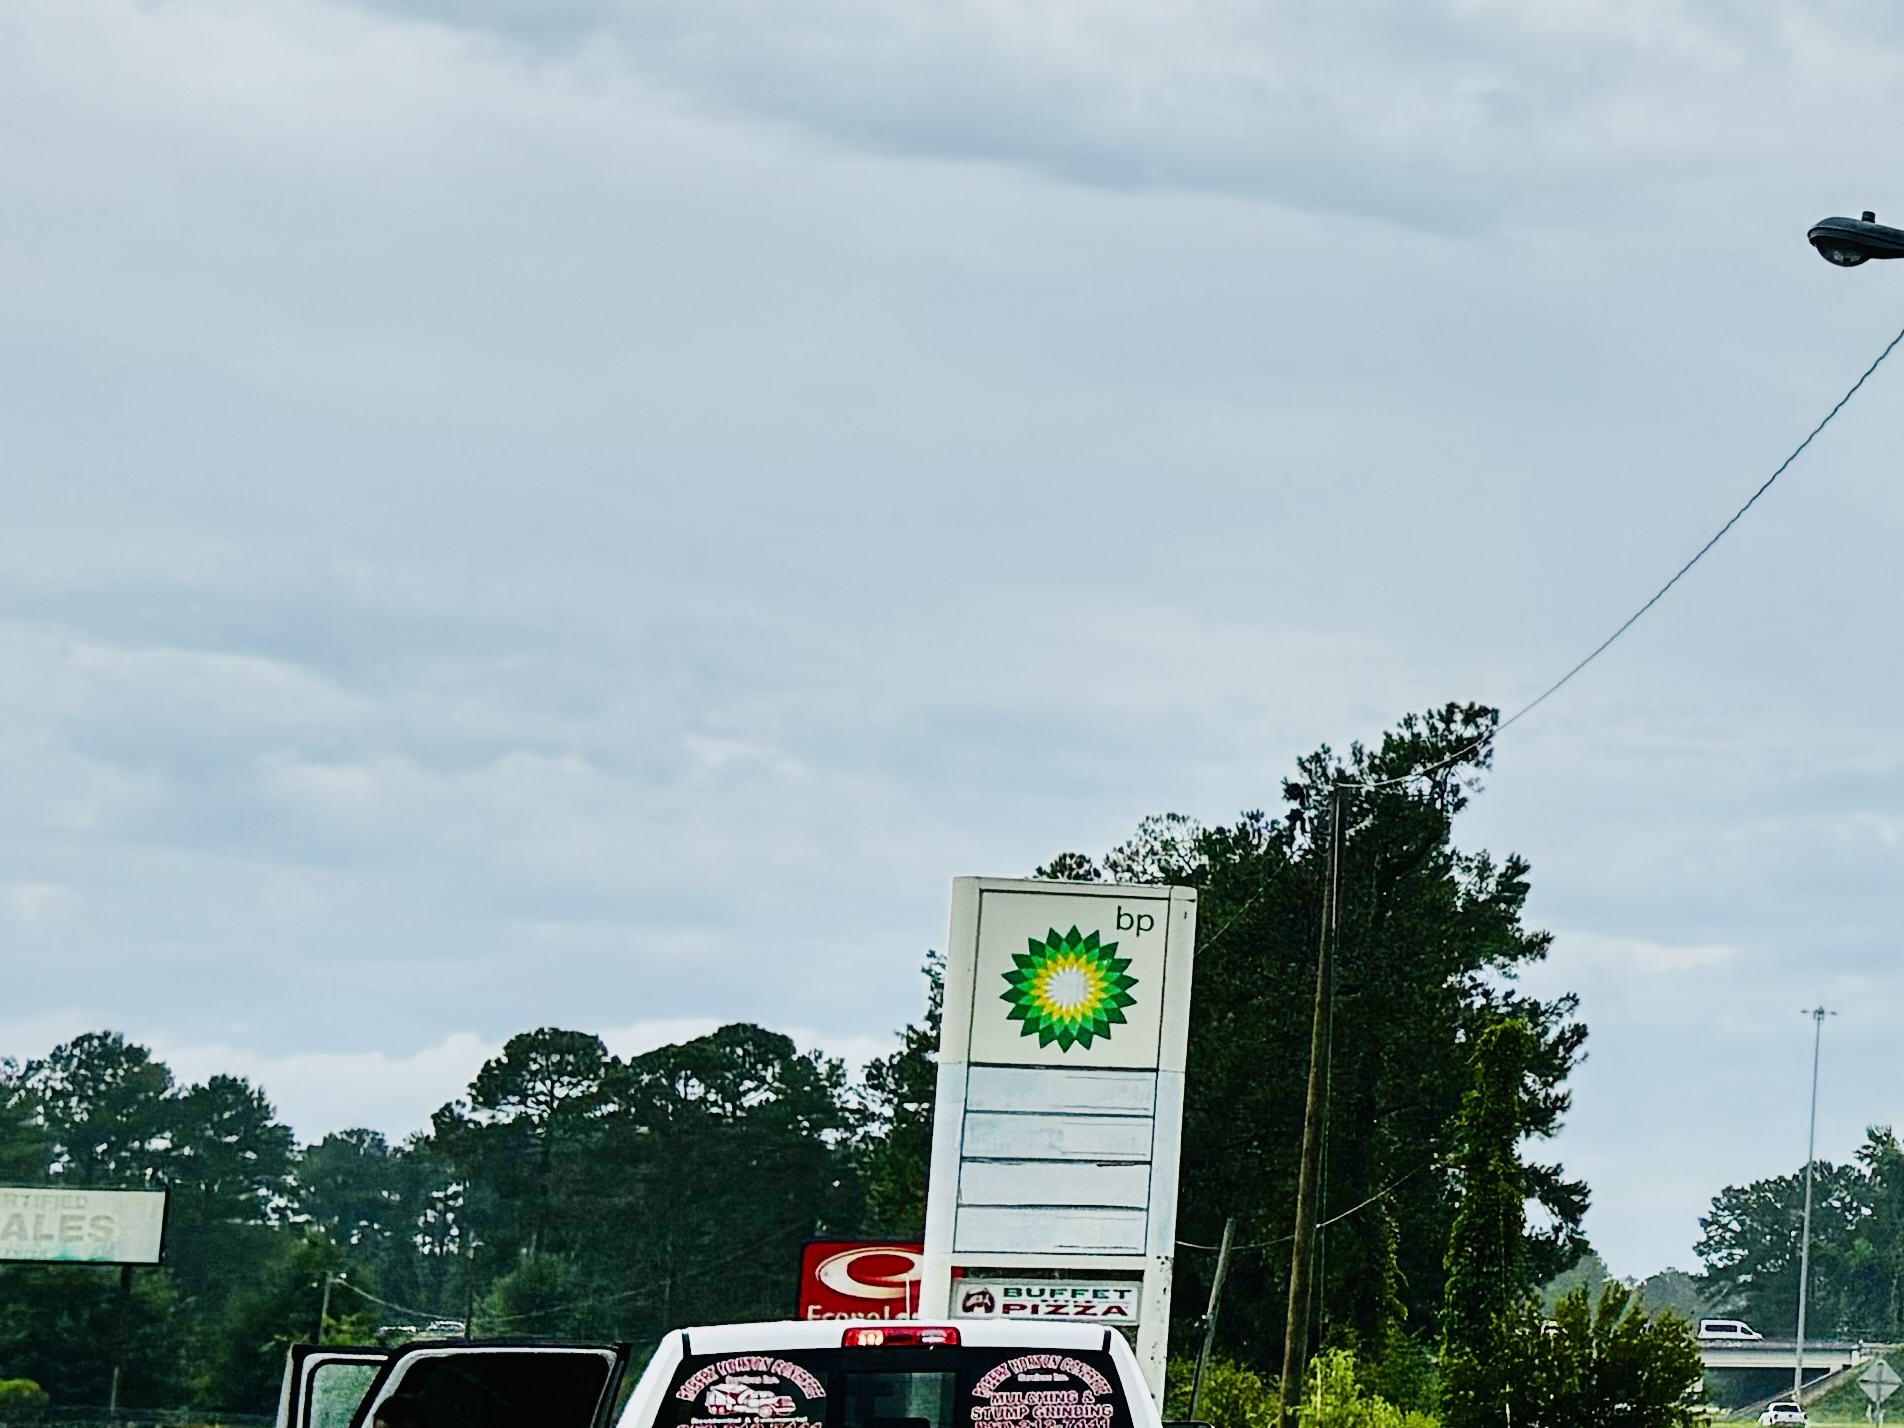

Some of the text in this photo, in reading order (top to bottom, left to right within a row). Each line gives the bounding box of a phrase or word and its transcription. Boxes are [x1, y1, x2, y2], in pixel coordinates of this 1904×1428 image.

[1115, 905, 1155, 937] bp
[1003, 1287, 1133, 1300] BUFFET
[1002, 1303, 1129, 1317] PIZZA
[970, 1403, 1114, 1421] STUMP GRINDING
